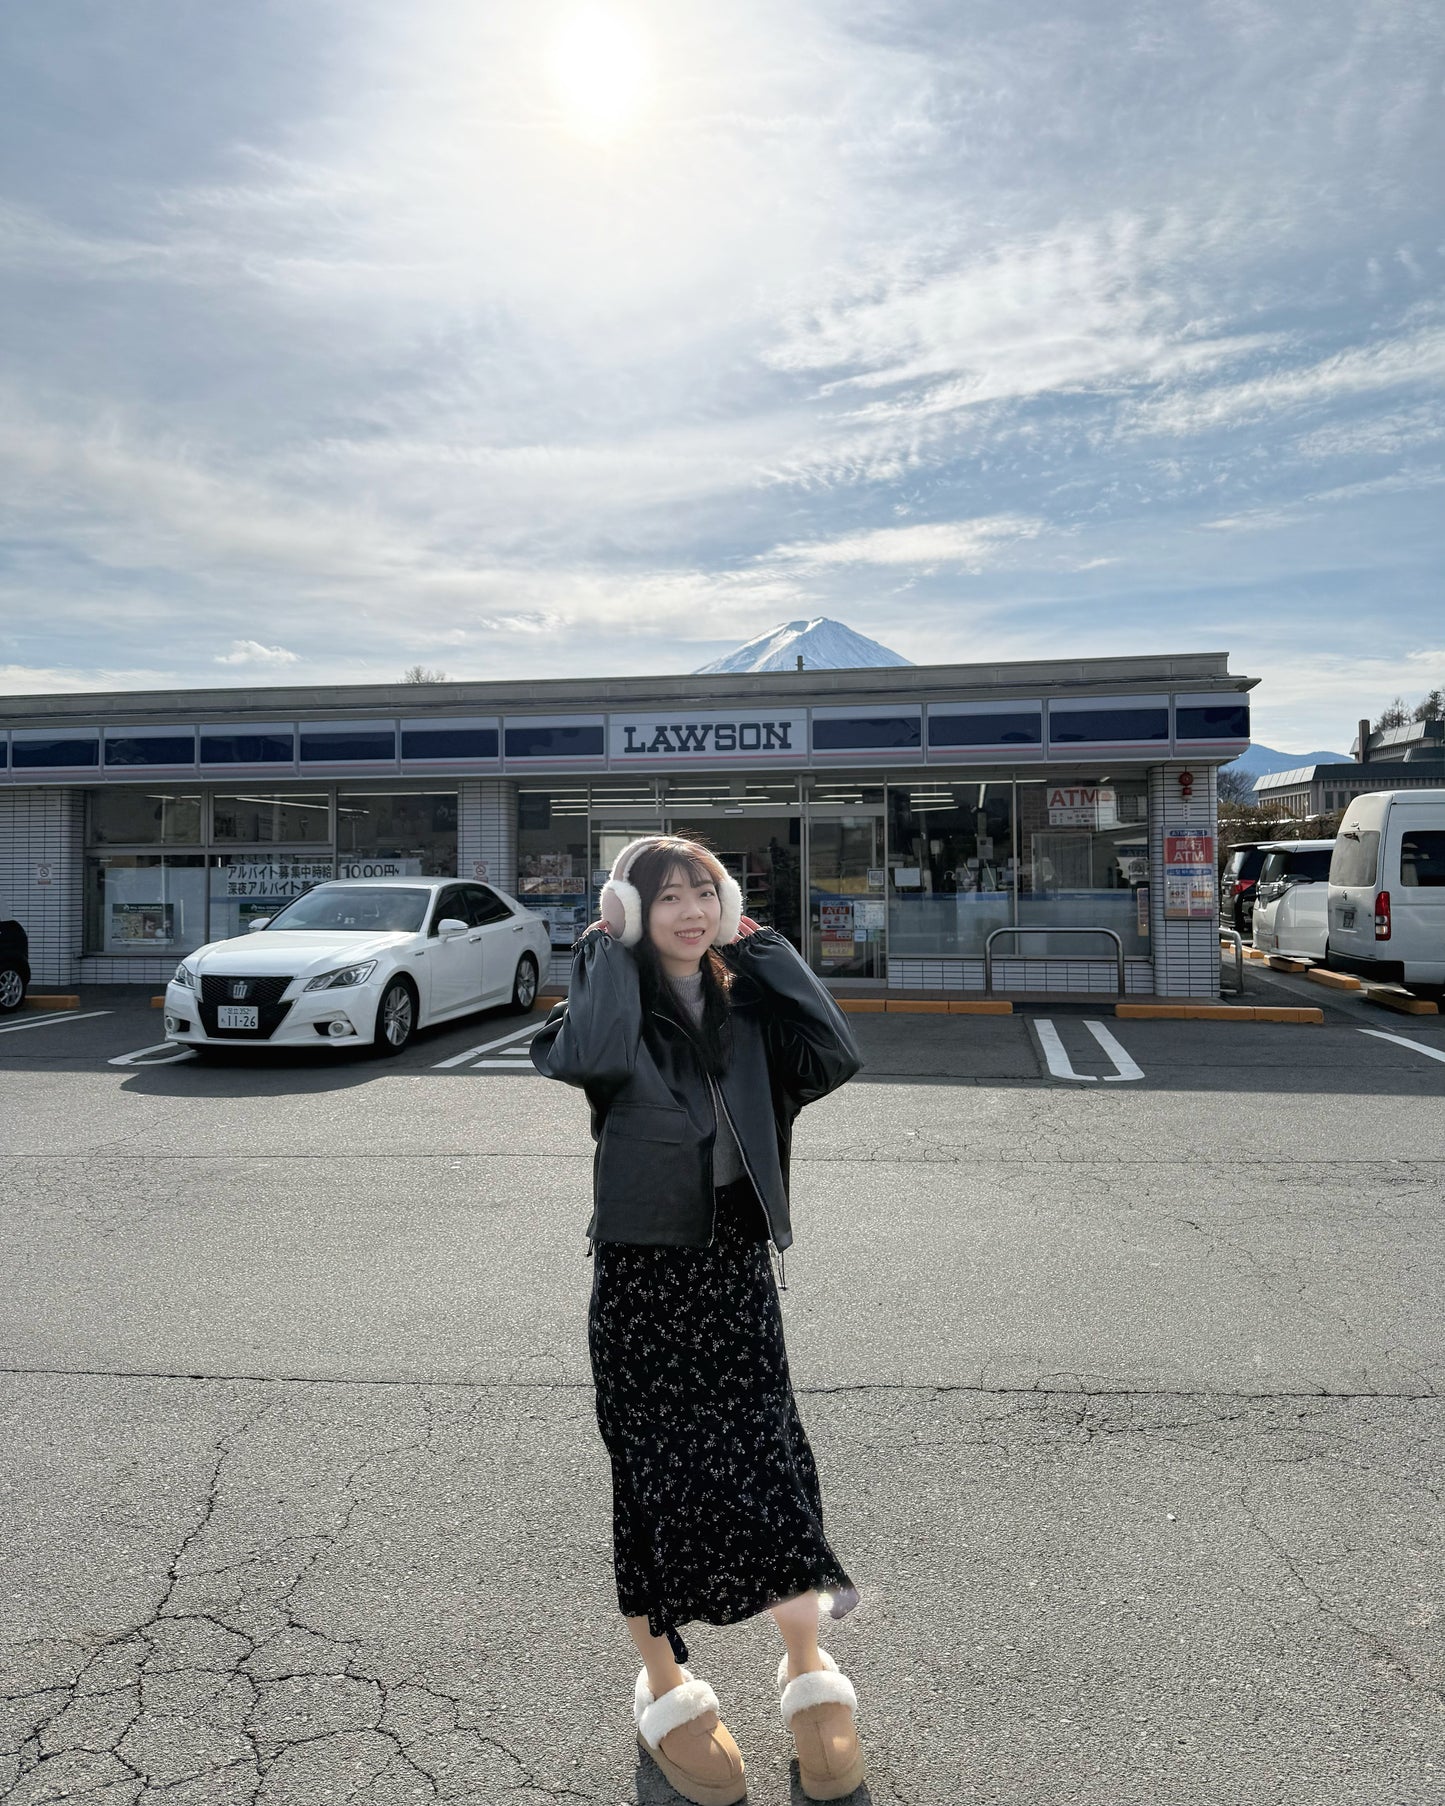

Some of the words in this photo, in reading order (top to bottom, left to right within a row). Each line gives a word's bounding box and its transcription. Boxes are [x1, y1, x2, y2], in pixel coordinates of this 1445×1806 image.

[623, 721, 792, 753] LAWSON
[1049, 788, 1099, 807] ATM
[1173, 850, 1204, 862] ATM
[227, 865, 332, 879] アルバイト募集中時給
[228, 1015, 256, 1027] 11-26
